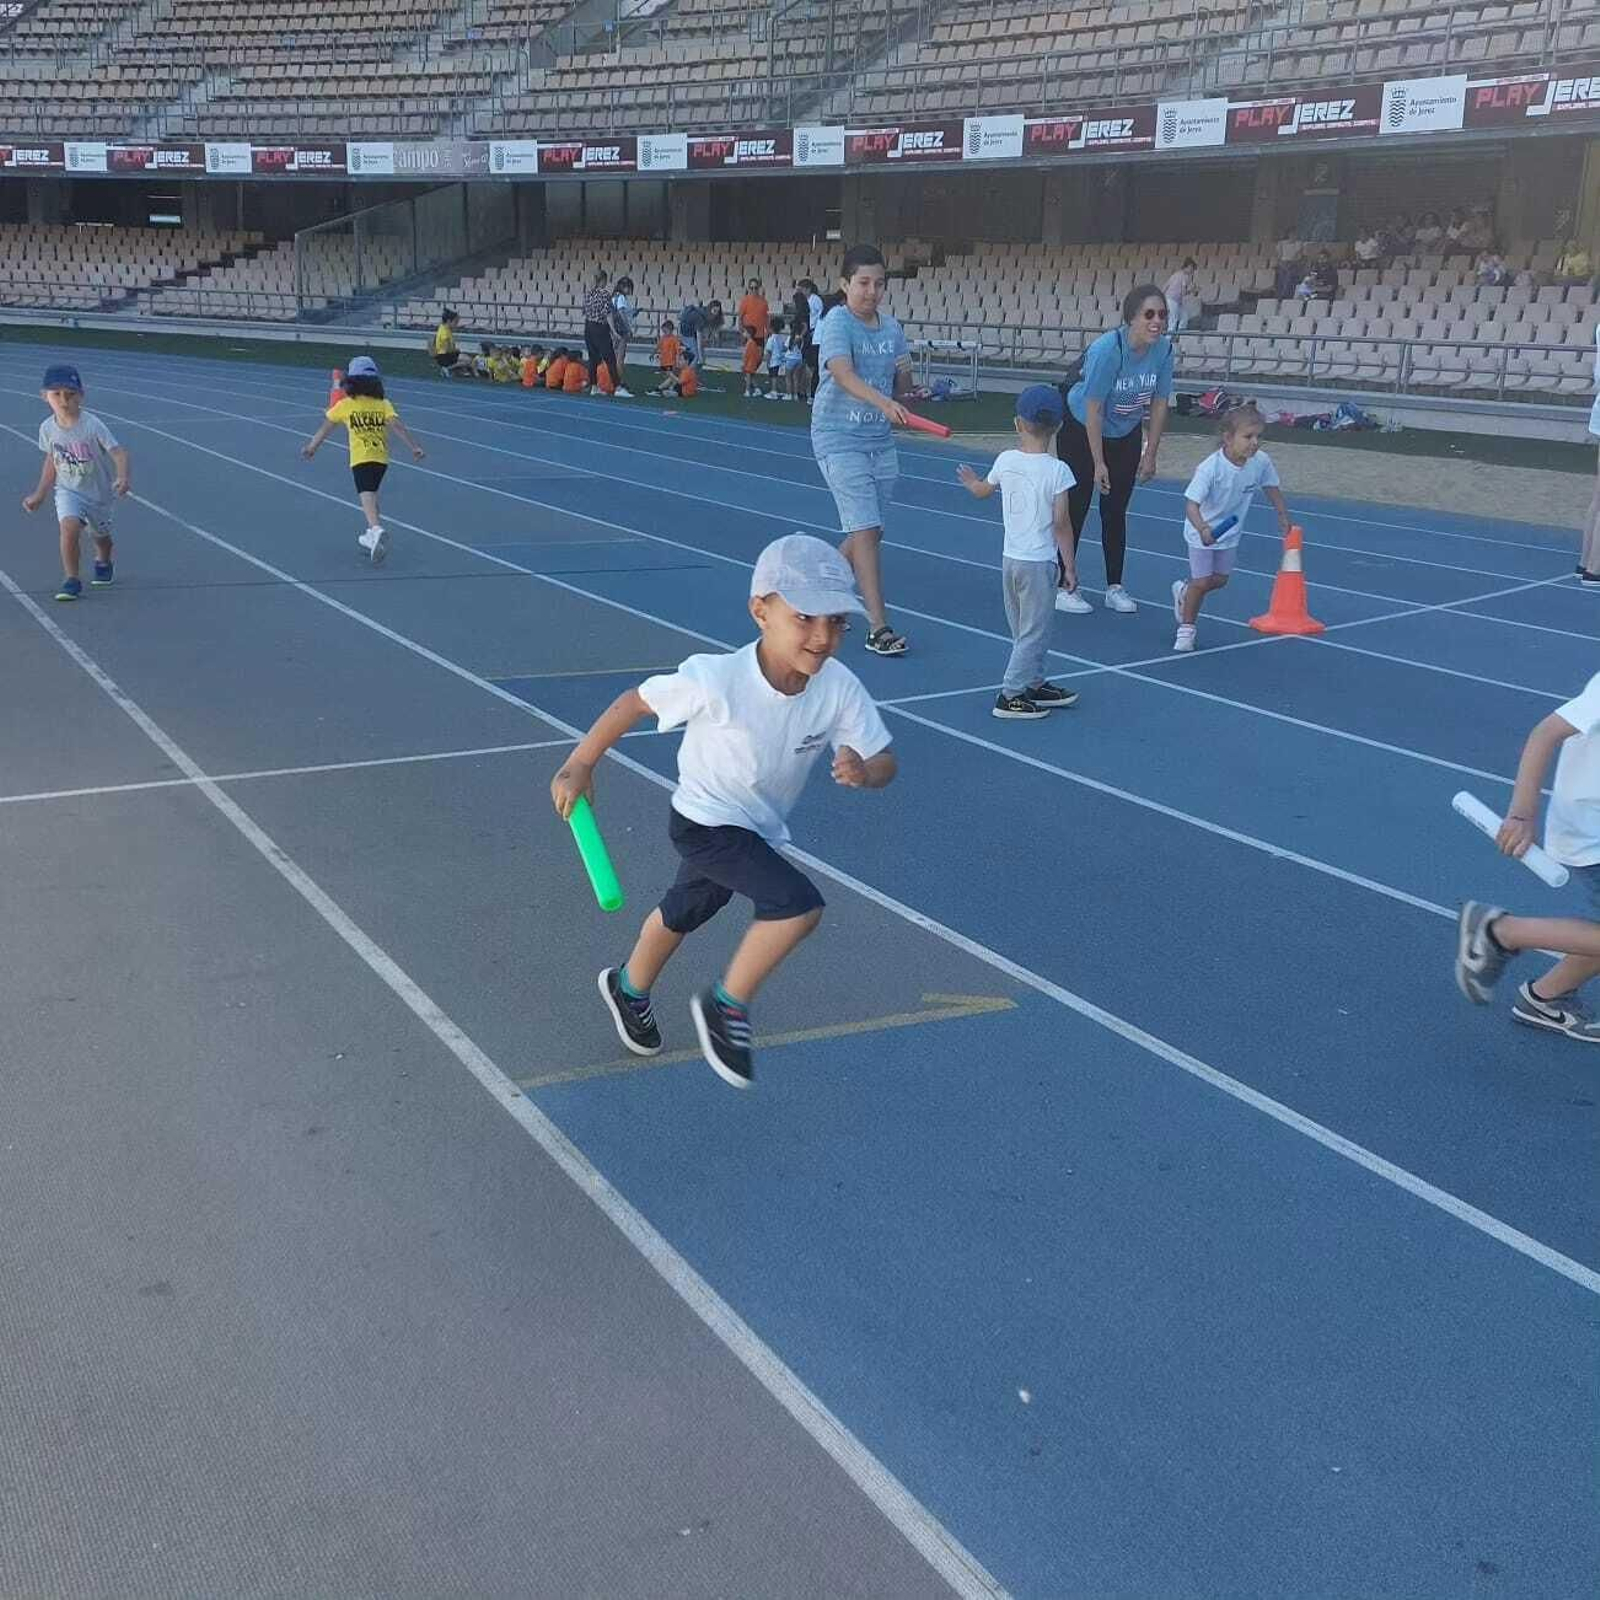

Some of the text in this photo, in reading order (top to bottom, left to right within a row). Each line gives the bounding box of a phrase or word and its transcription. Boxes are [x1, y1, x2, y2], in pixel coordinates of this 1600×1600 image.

[1475, 83, 1540, 109] PLAY
[1235, 105, 1289, 128] PLAY
[1278, 99, 1356, 135] JEREZ
[852, 134, 896, 151] PLAY
[887, 131, 944, 157] JEREZ
[1030, 118, 1135, 149] PLAY JEREZ
[256, 151, 292, 163] PLAY
[543, 149, 579, 163] PLAY
[573, 146, 620, 168] JEREZ
[693, 142, 731, 157] PLAY
[724, 139, 776, 163] JEREZ
[1140, 373, 1157, 388] YOR
[849, 410, 886, 424] NOIS
